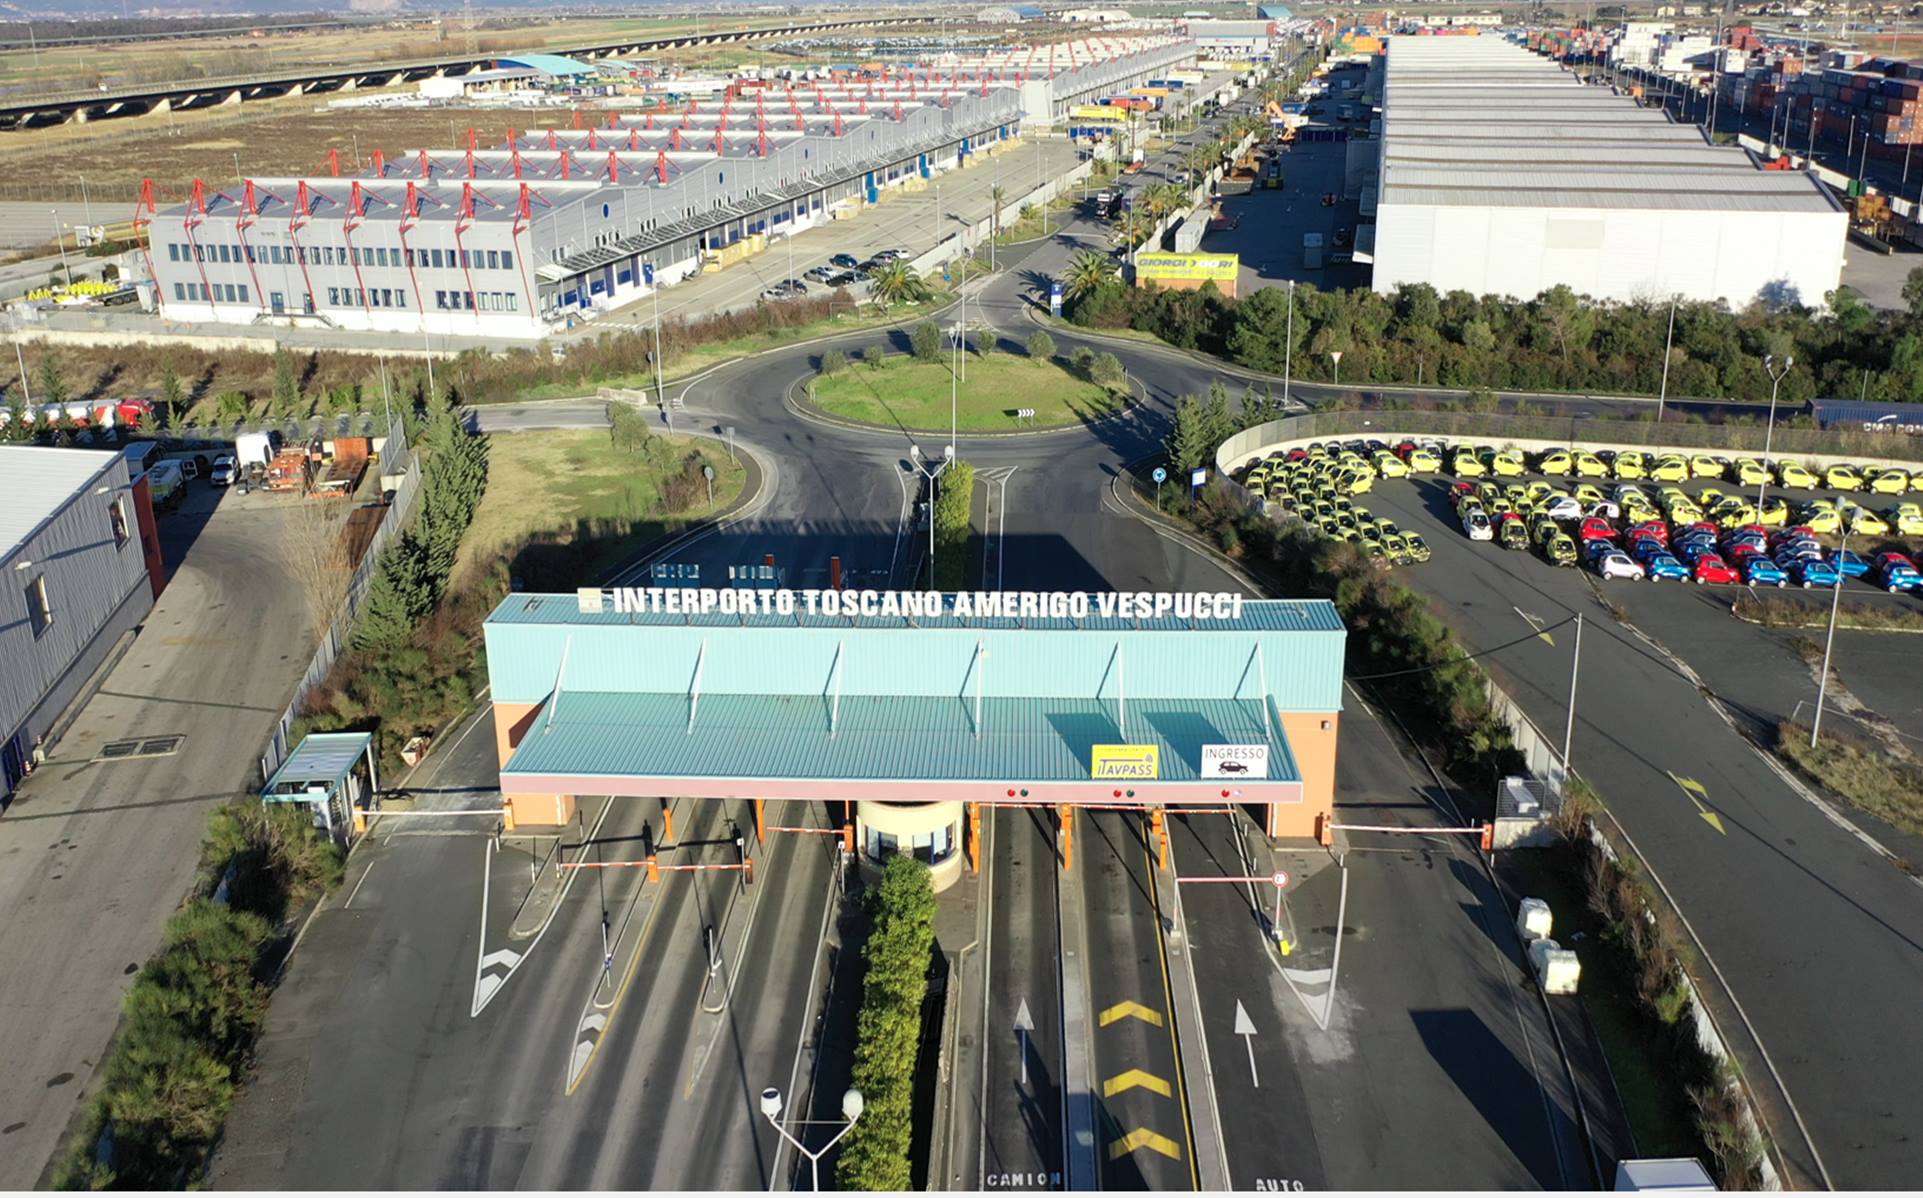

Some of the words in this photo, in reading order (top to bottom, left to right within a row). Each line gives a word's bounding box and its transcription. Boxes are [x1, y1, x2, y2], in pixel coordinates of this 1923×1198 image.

[613, 587, 794, 615] INTERPORTO
[802, 589, 943, 617] TOSCANO
[953, 590, 1088, 618] AMERIGO
[1096, 591, 1242, 619] VESPUCCI
[1205, 748, 1265, 759] INGRESSO
[987, 1173, 1060, 1186] CAMION
[1256, 1178, 1304, 1191] AUTO
